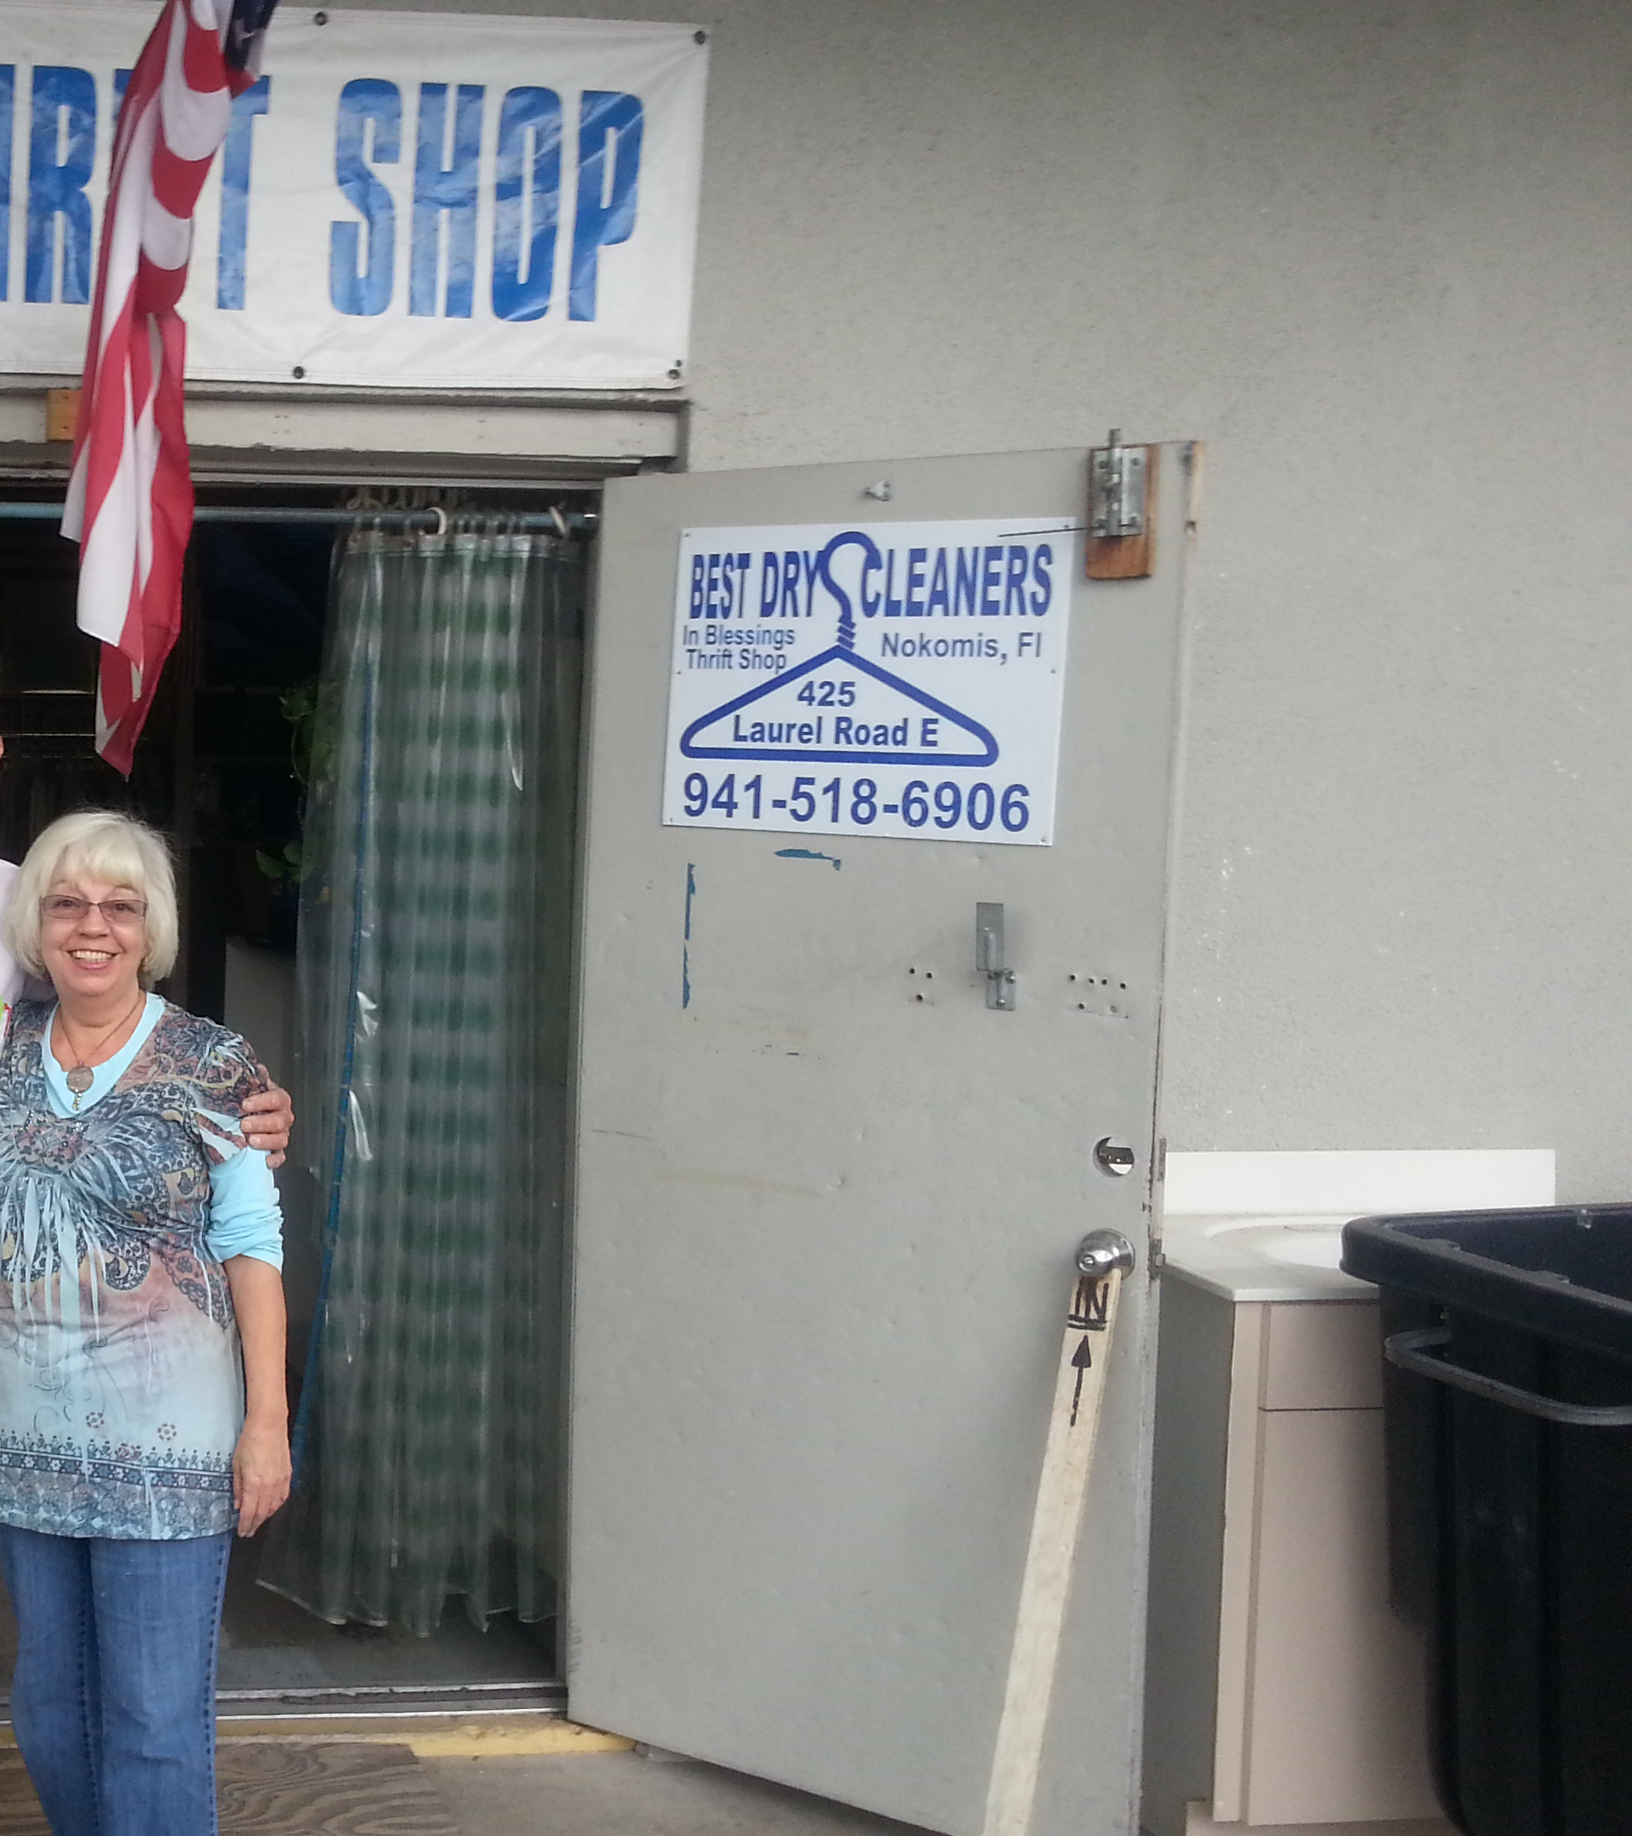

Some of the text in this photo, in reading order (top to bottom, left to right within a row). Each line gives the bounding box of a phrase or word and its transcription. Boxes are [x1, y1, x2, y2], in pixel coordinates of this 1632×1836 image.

[329, 77, 644, 322] SHOP
[690, 544, 1053, 619] BEST DRY CLEANERS
[683, 624, 795, 651] In Blessings
[882, 632, 1007, 666] Nokomis,
[686, 648, 787, 674] Thrift Shop
[798, 681, 856, 707] 425
[733, 715, 938, 747] Laurel Road E
[684, 772, 1029, 832] 941-518-6906
[1075, 1277, 1109, 1321] IN
